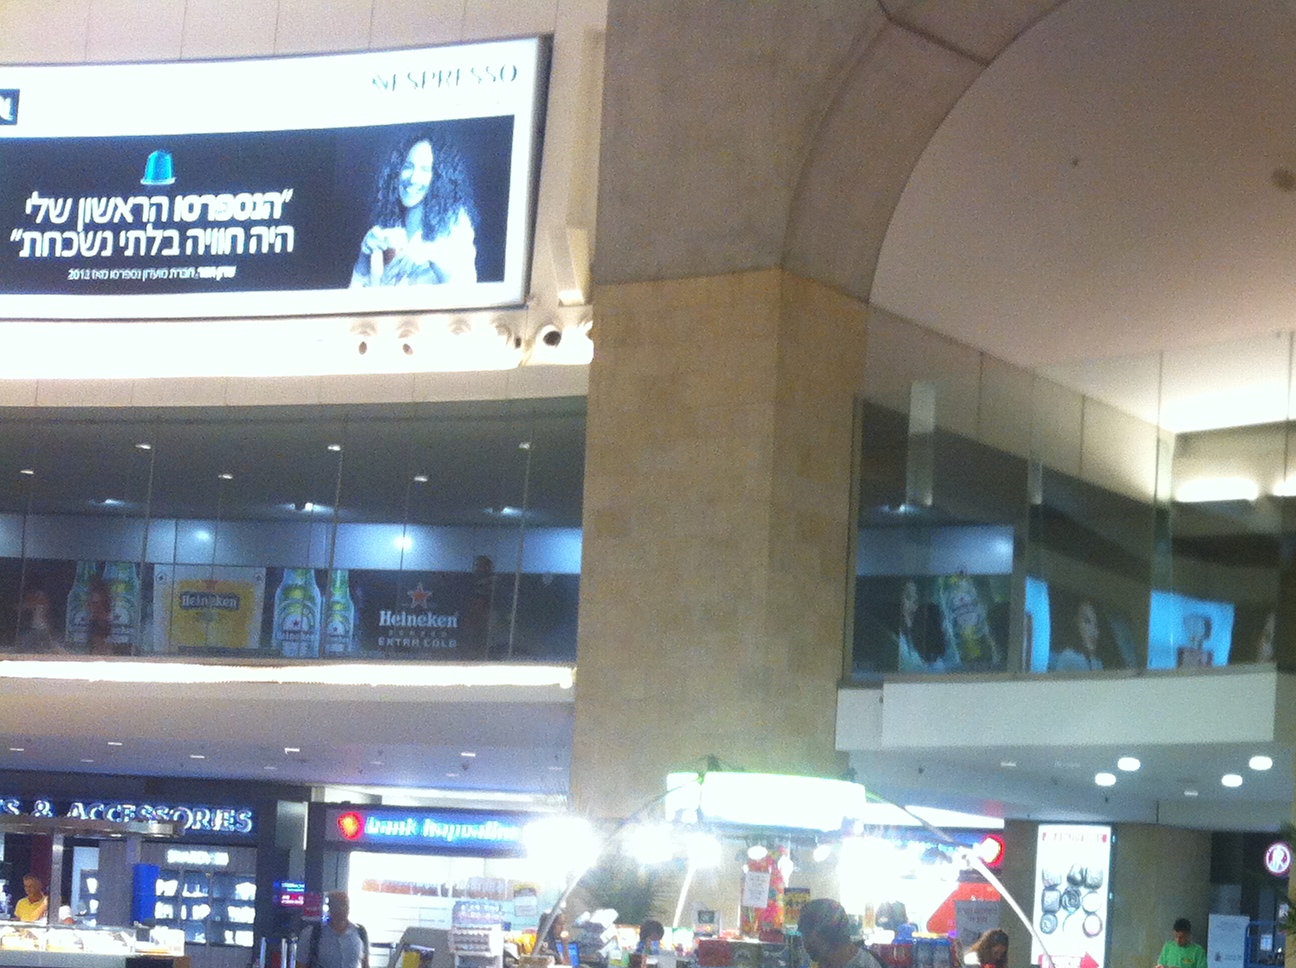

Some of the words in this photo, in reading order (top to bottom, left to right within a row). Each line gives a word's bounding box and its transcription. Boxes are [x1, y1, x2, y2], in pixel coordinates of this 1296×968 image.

[25, 191, 73, 224] שלי
[77, 195, 170, 232] הראשון
[119, 223, 181, 256] בלתי
[249, 225, 295, 254] היה
[379, 610, 458, 628] Heineken
[378, 636, 420, 647] EXTRA
[0, 799, 20, 816] S
[67, 802, 254, 833] ACCESSORIES
